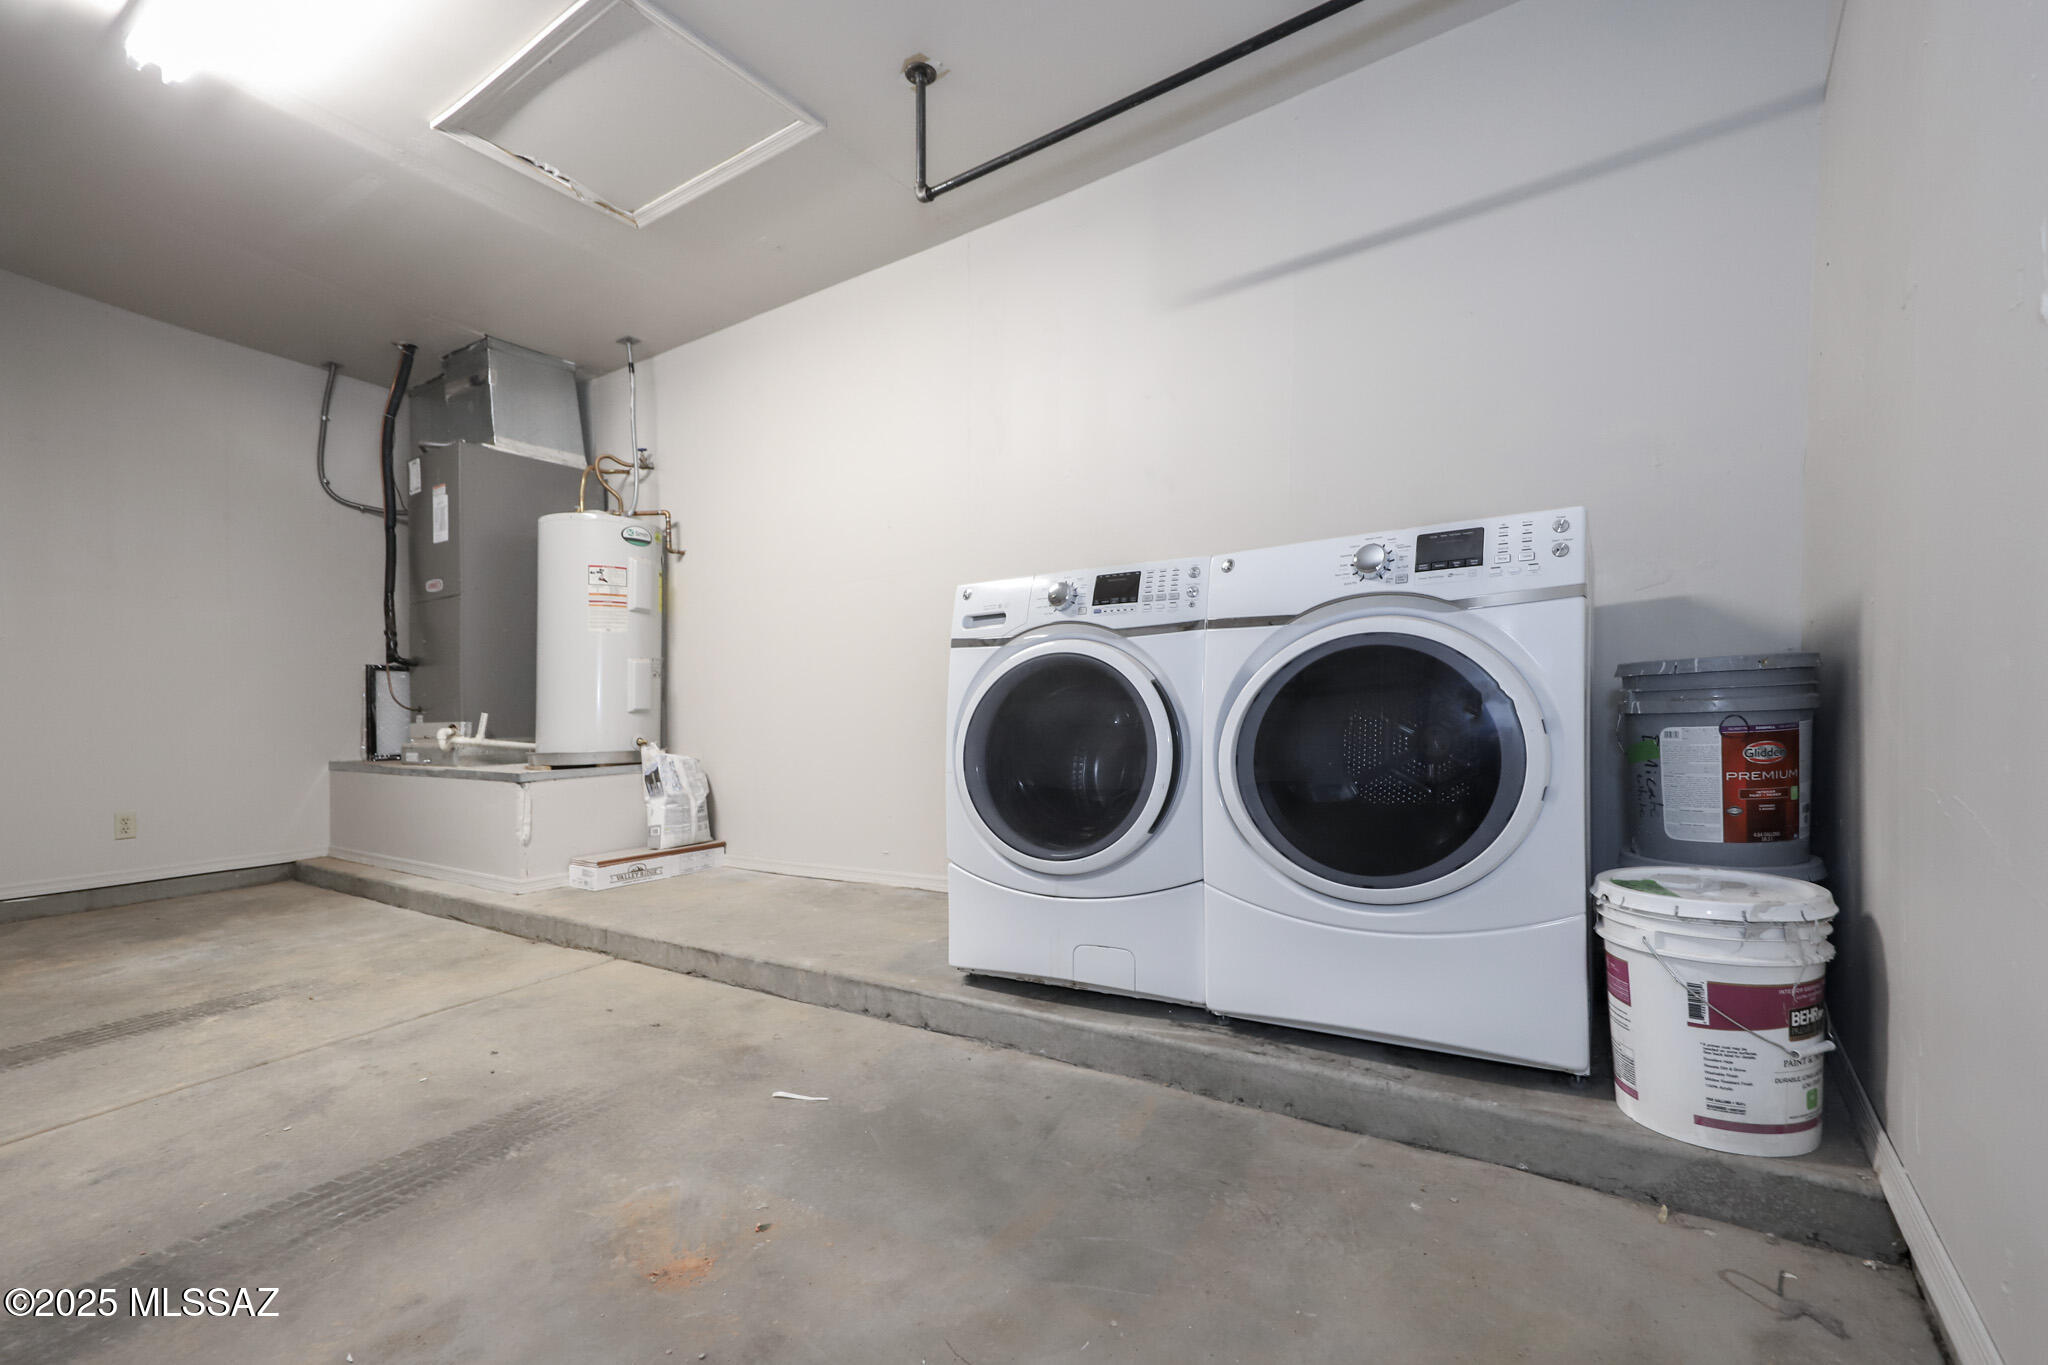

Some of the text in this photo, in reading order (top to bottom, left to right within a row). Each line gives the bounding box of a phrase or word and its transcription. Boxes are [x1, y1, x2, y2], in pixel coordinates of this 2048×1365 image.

[1726, 769, 1798, 781] PREMIUM
[1791, 1007, 1818, 1027] BEHR
[1783, 1056, 1807, 1068] PAINT
